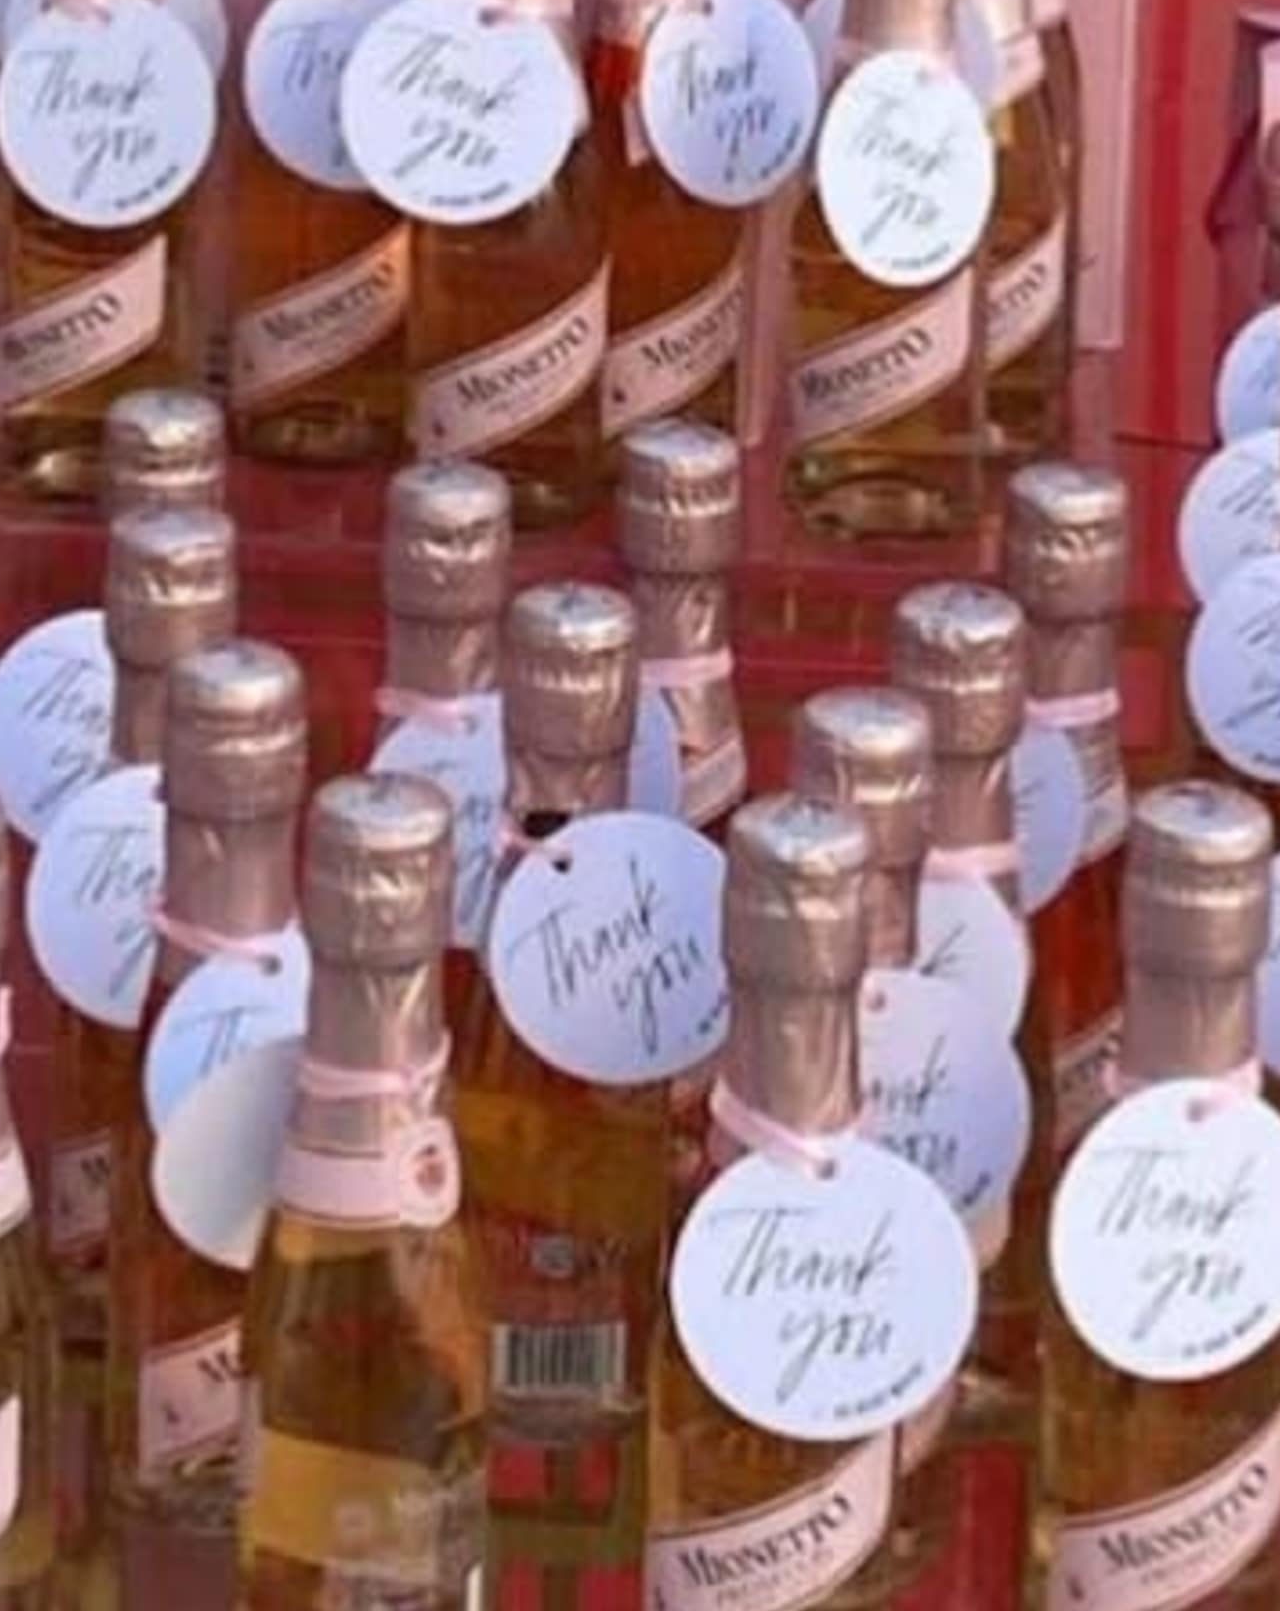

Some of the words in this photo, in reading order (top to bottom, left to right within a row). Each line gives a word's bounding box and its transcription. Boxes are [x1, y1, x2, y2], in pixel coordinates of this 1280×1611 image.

[19, 47, 158, 121] Thank
[373, 28, 527, 121] Thank
[72, 126, 157, 202] you
[393, 114, 499, 179] you
[456, 315, 589, 406] MIONETTO
[505, 851, 670, 1009] Thank
[611, 934, 705, 1057] you
[1094, 1145, 1260, 1237] Thank
[706, 1206, 894, 1298] Thank
[1131, 1250, 1245, 1342] you
[776, 1309, 893, 1405] you
[677, 1491, 855, 1588] MIONETTO
[1097, 1460, 1270, 1575] MIONETTO
